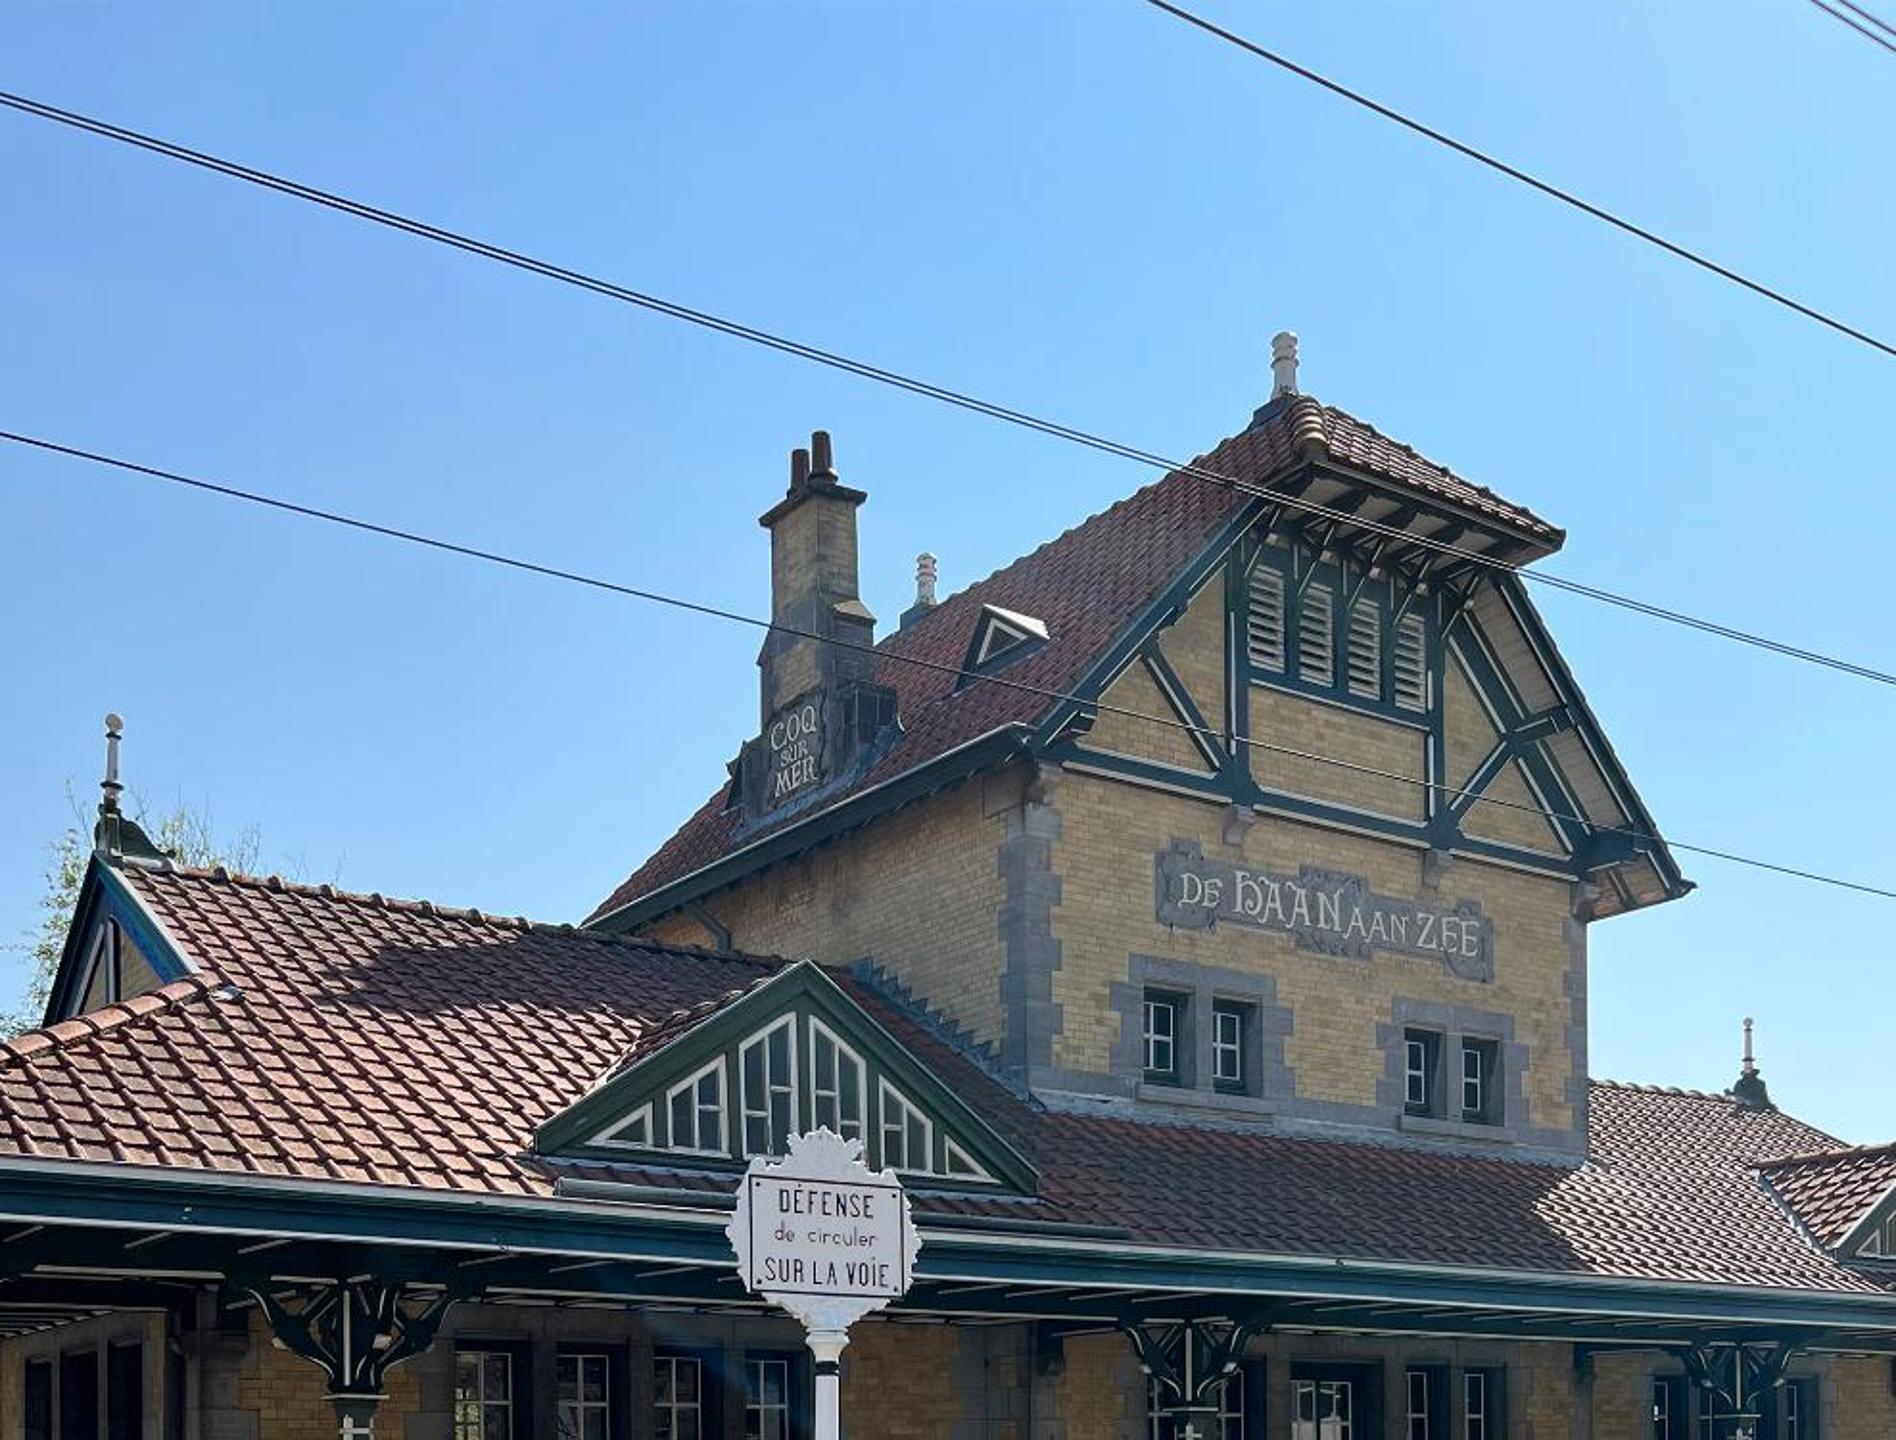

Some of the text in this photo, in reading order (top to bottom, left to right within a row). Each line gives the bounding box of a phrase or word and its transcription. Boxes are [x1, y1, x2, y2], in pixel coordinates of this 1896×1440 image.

[771, 705, 817, 751] COQ
[774, 754, 819, 799] MER
[1178, 872, 1223, 908] DE
[1341, 907, 1410, 944] AAN
[1416, 912, 1480, 956] ZEE
[774, 1220, 879, 1248] de circuler
[764, 1256, 805, 1284] SUR
[812, 1260, 839, 1287] LA
